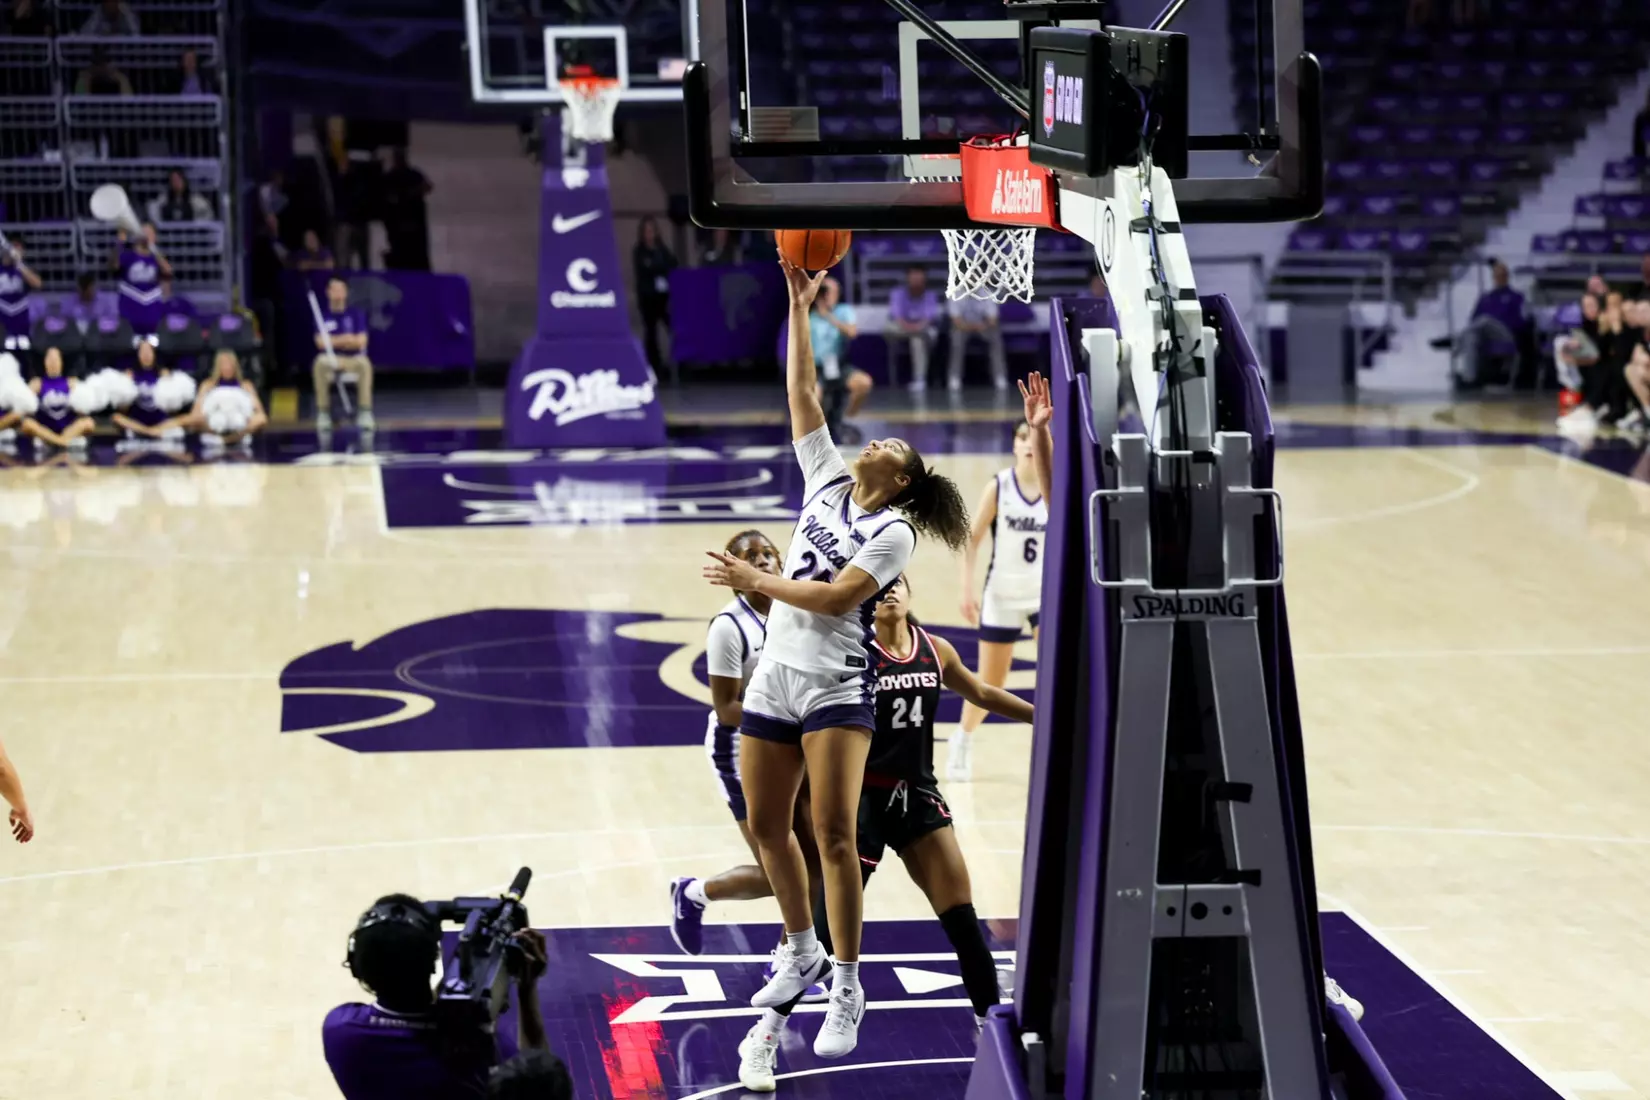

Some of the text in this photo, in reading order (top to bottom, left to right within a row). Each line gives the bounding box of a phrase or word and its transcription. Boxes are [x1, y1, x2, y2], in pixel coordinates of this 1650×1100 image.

[1023, 537, 1038, 564] 6
[1132, 593, 1244, 619] SPALDING
[891, 695, 925, 730] 24
